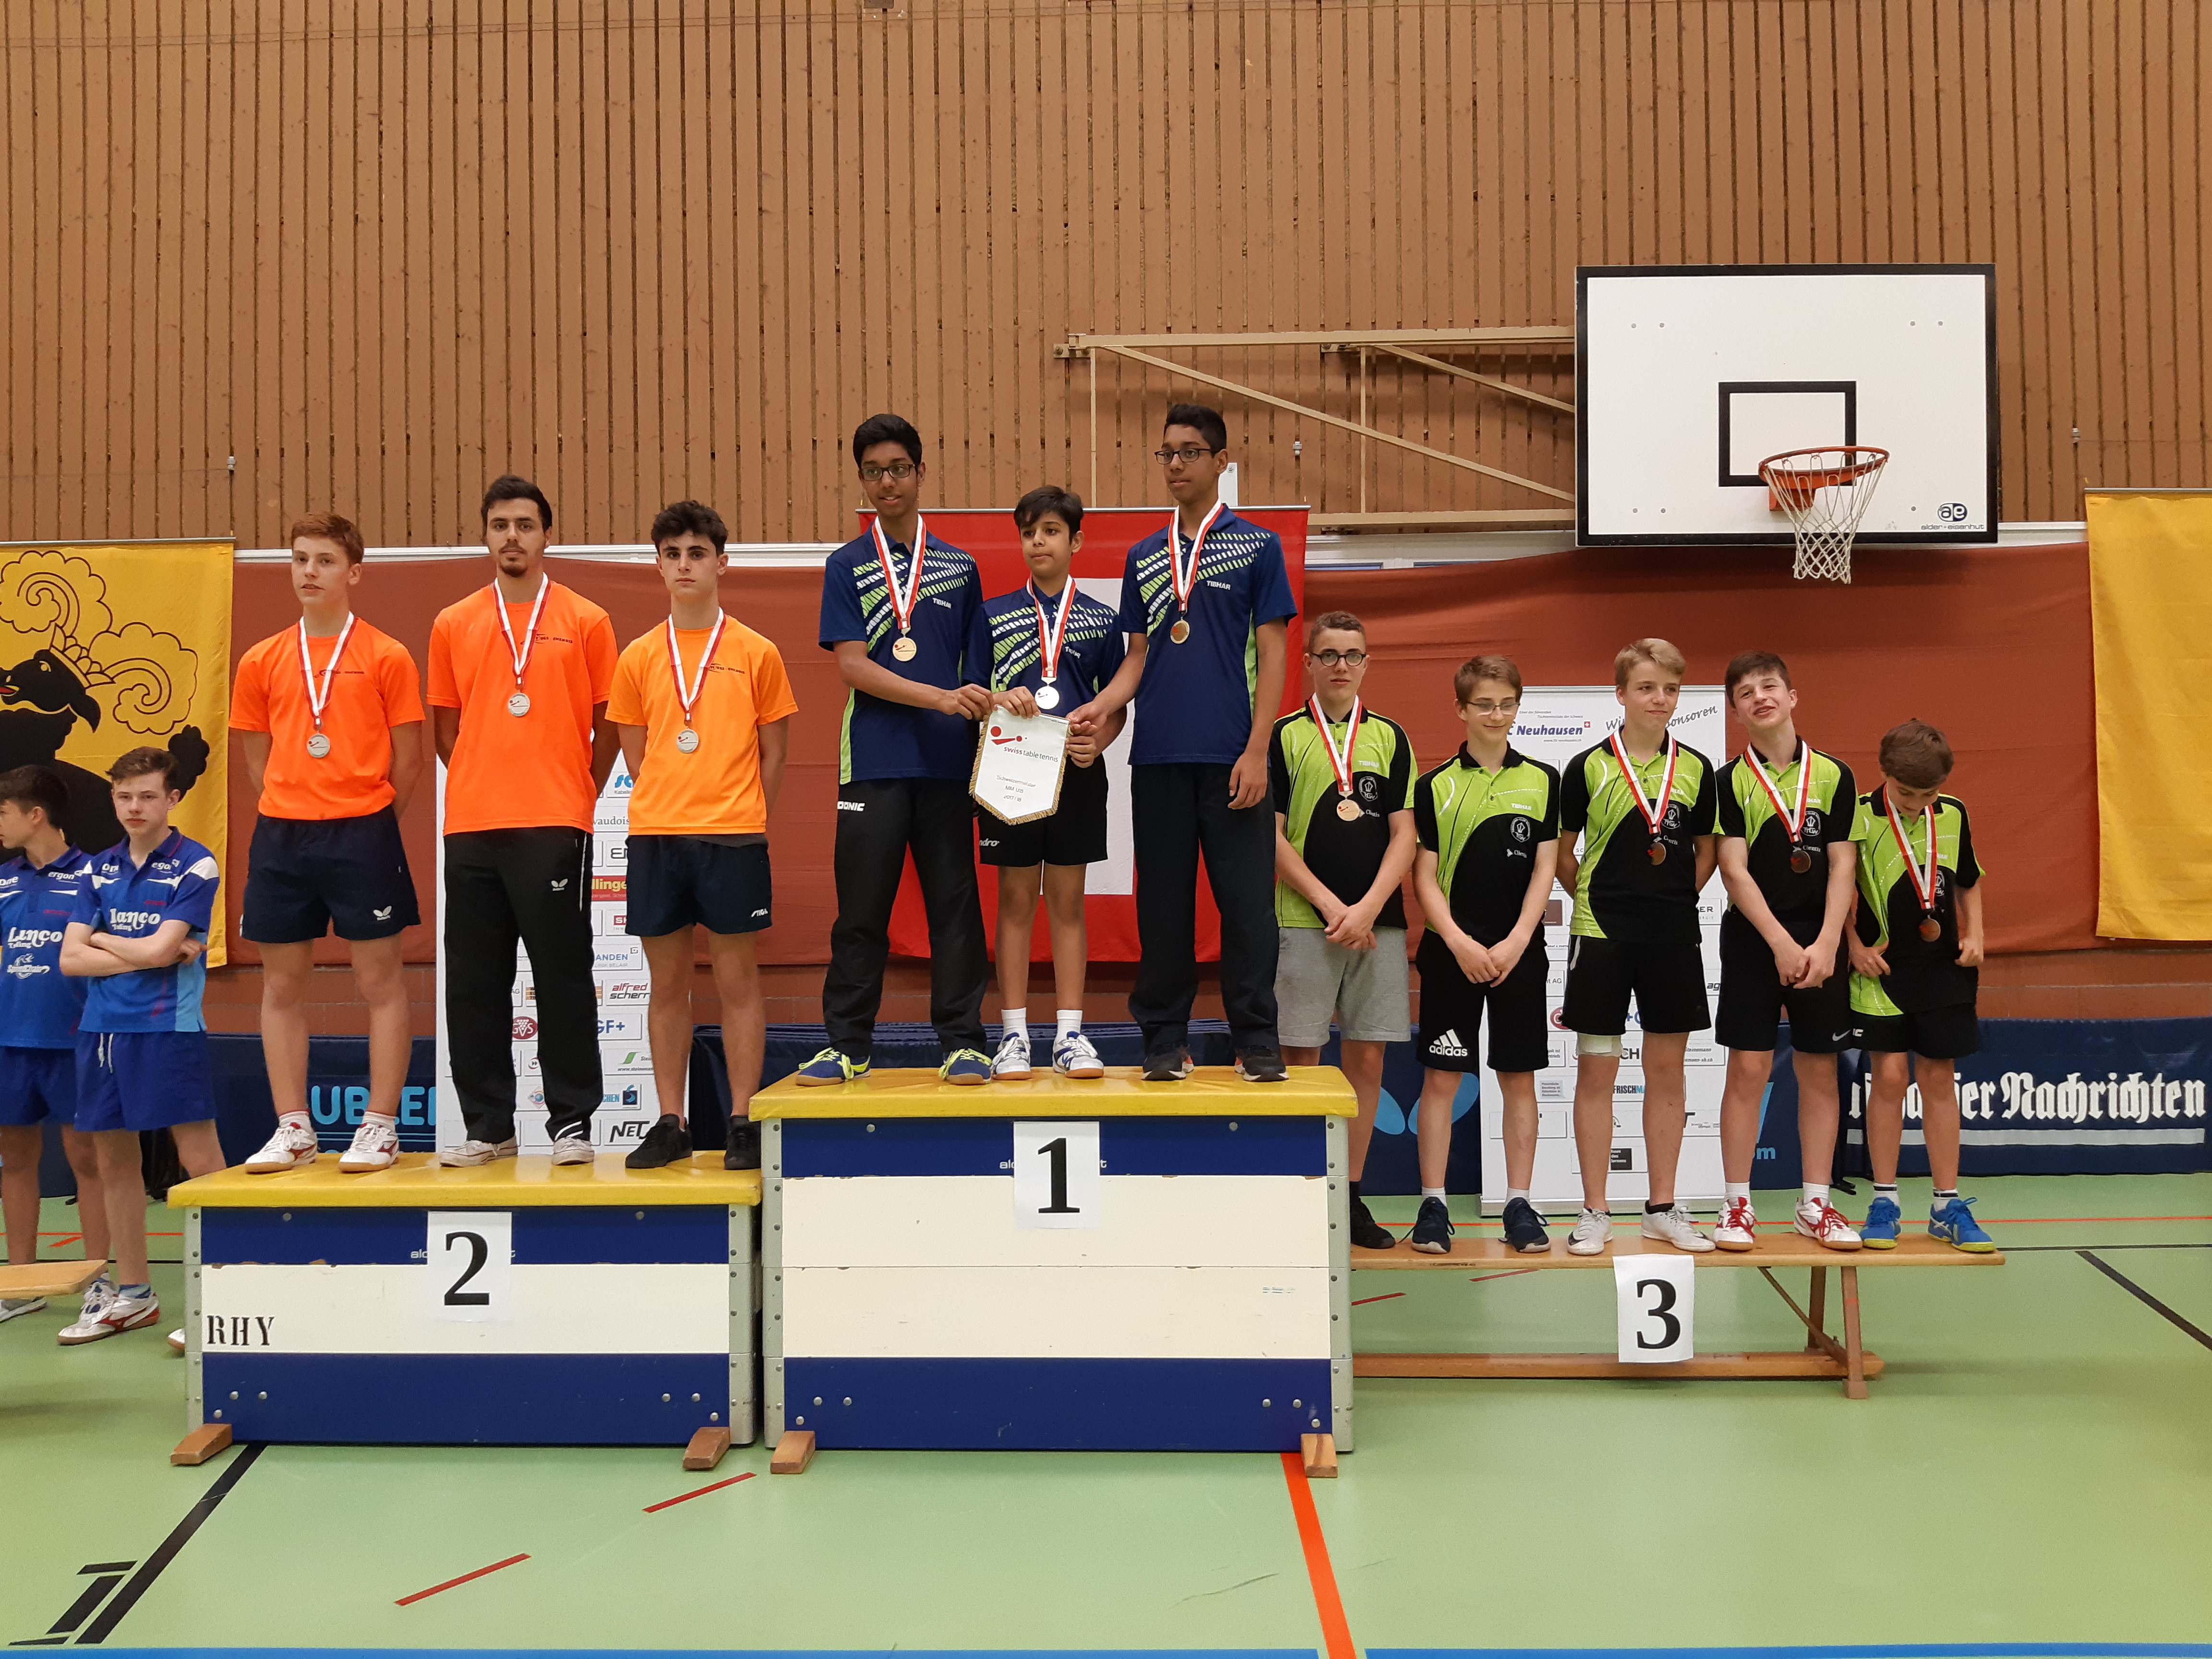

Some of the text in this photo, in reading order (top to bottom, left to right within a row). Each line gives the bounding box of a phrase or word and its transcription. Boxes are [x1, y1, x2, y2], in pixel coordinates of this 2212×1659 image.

[1206, 580, 1231, 590] TIBHAR
[1516, 725, 1583, 735] Neuhausen
[1003, 746, 1058, 763] swiss table tennis
[837, 801, 865, 811] DONIC
[612, 983, 648, 992] alfred
[1429, 1045, 1468, 1057] adidas
[2000, 1072, 2207, 1123] Nachrichten
[1038, 1138, 1080, 1213] 1
[445, 1232, 490, 1305] 2
[1636, 1279, 1680, 1349] 3
[207, 1315, 275, 1346] RHY
